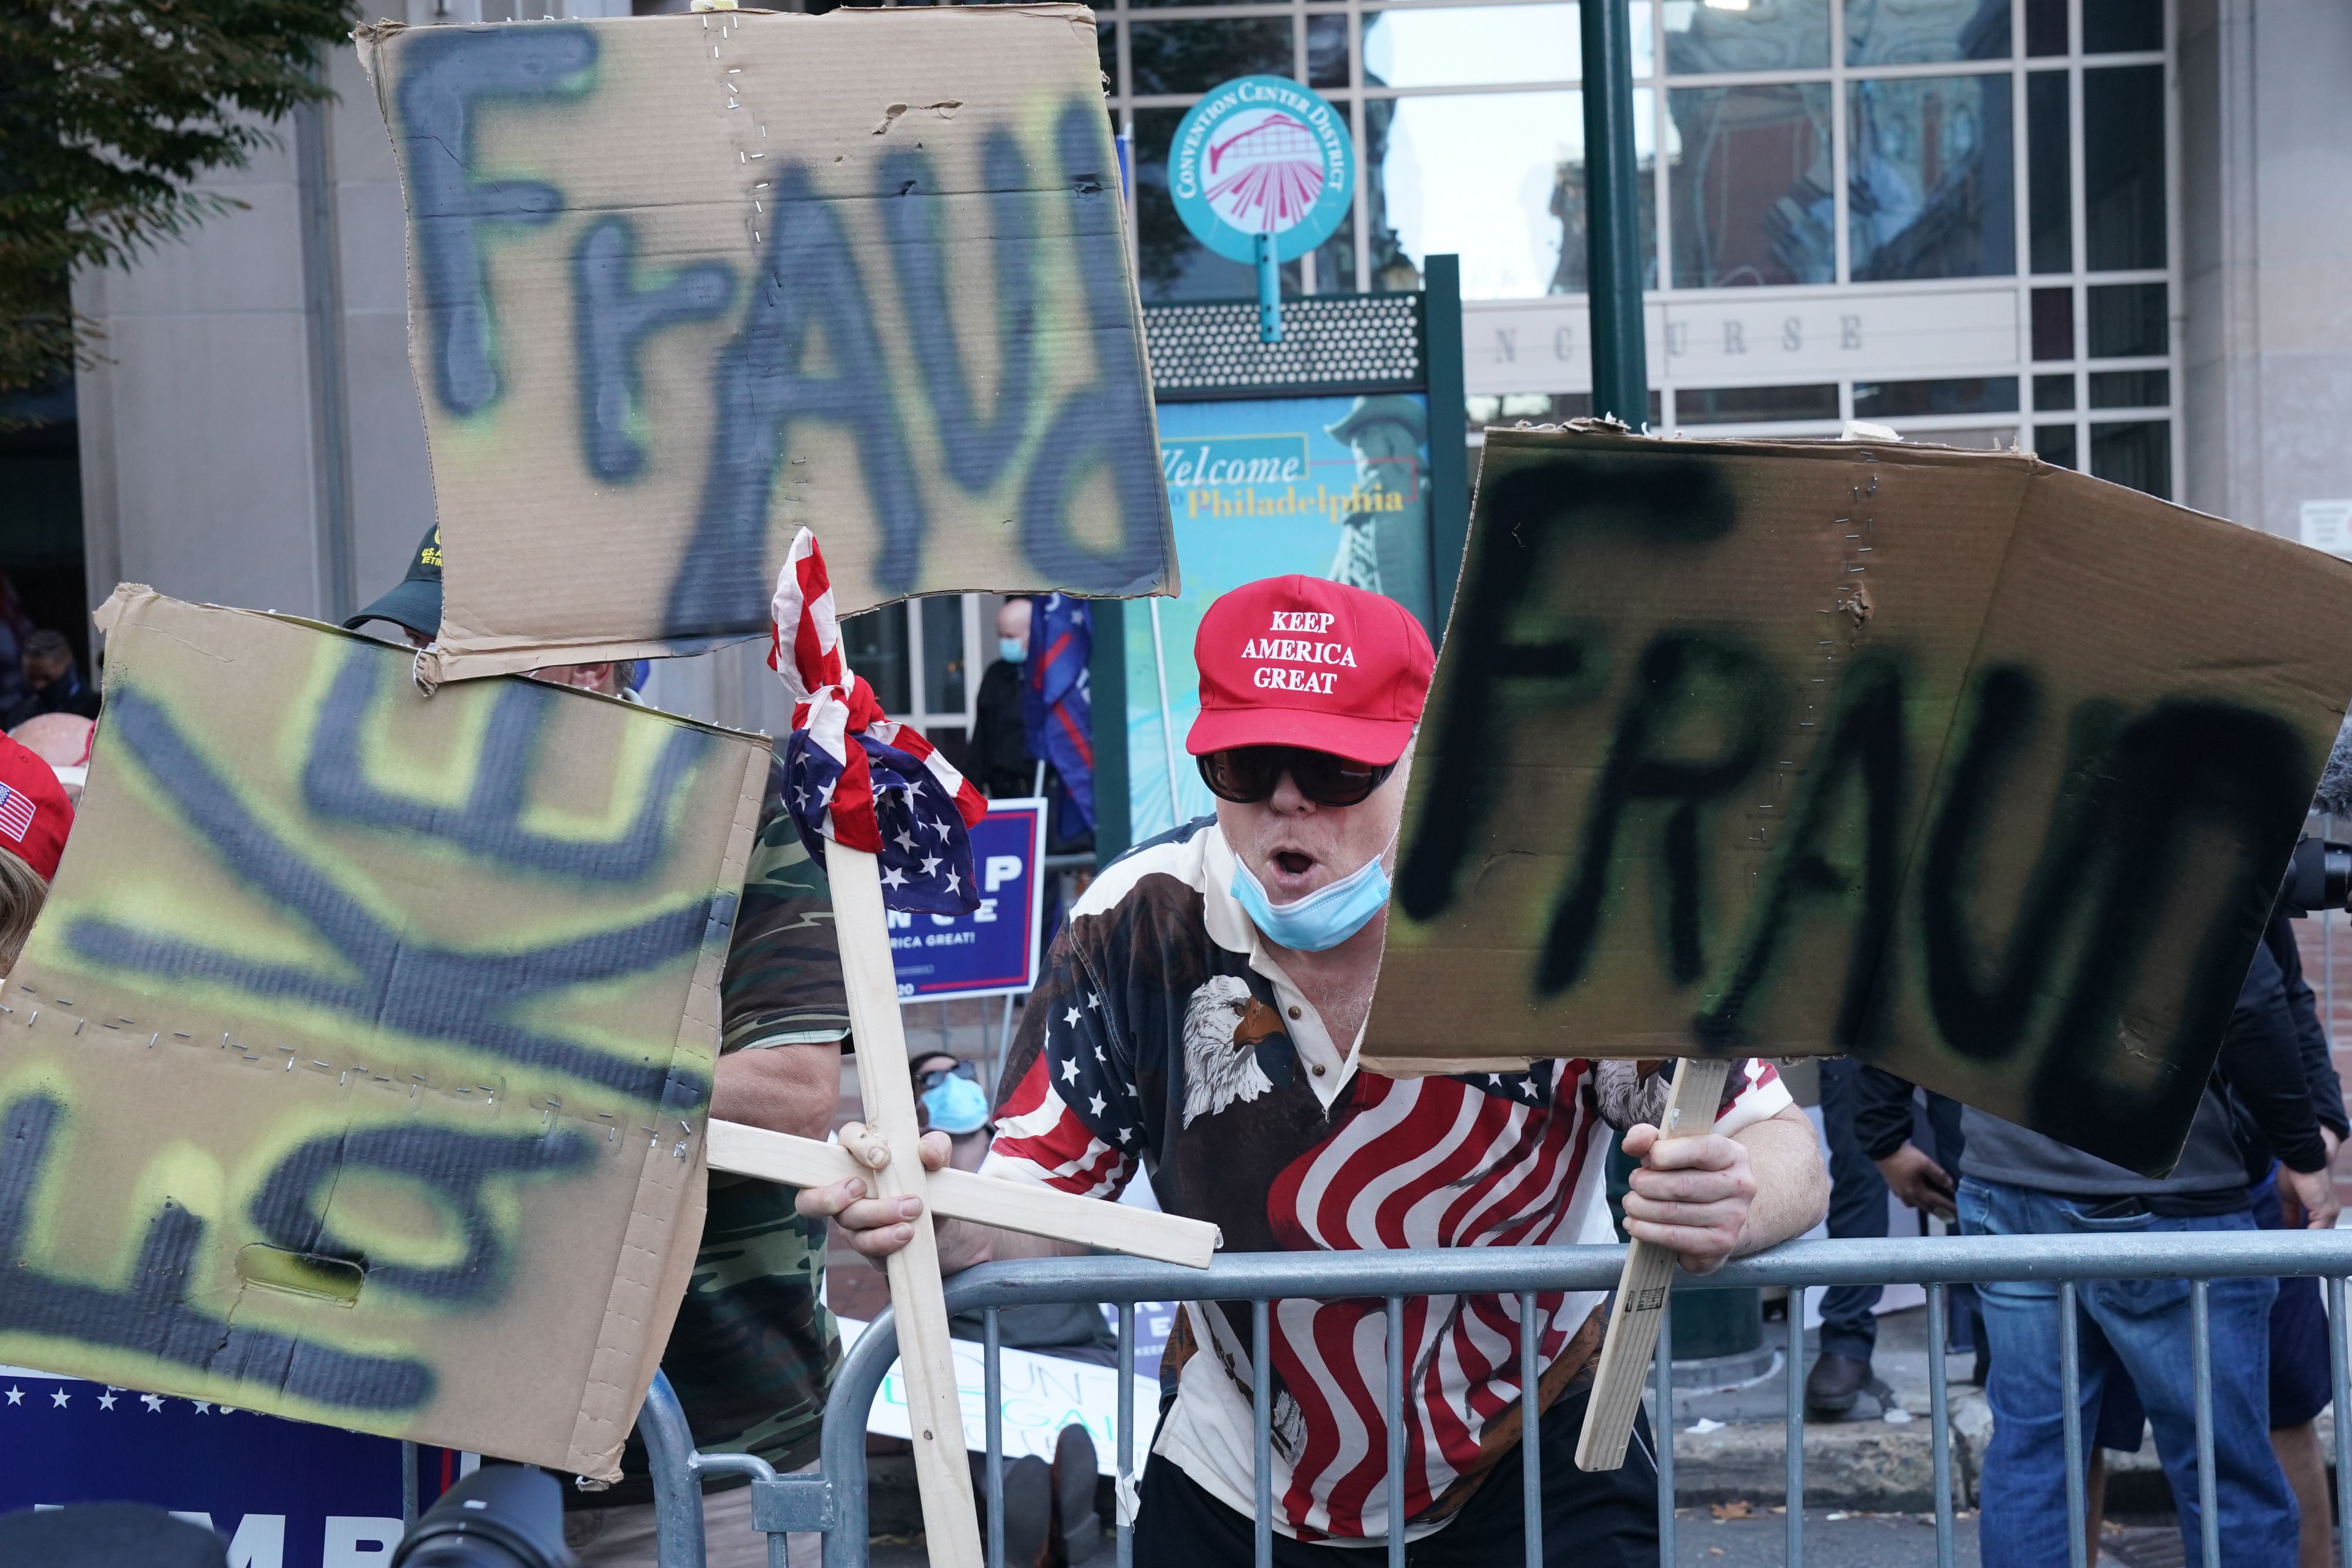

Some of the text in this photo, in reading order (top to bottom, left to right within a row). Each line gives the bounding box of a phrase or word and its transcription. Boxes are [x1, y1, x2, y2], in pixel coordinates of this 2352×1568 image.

[1176, 81, 1346, 199] CONVENTION CENTER DISTRICT
[1188, 483, 1403, 523] Philadelphia
[1269, 611, 1335, 633] KEEP
[1241, 638, 1357, 668] AMERICA
[1254, 667, 1337, 694] GREAT
[1392, 457, 2314, 1175] FRAUD
[926, 931, 975, 947] GREAT!
